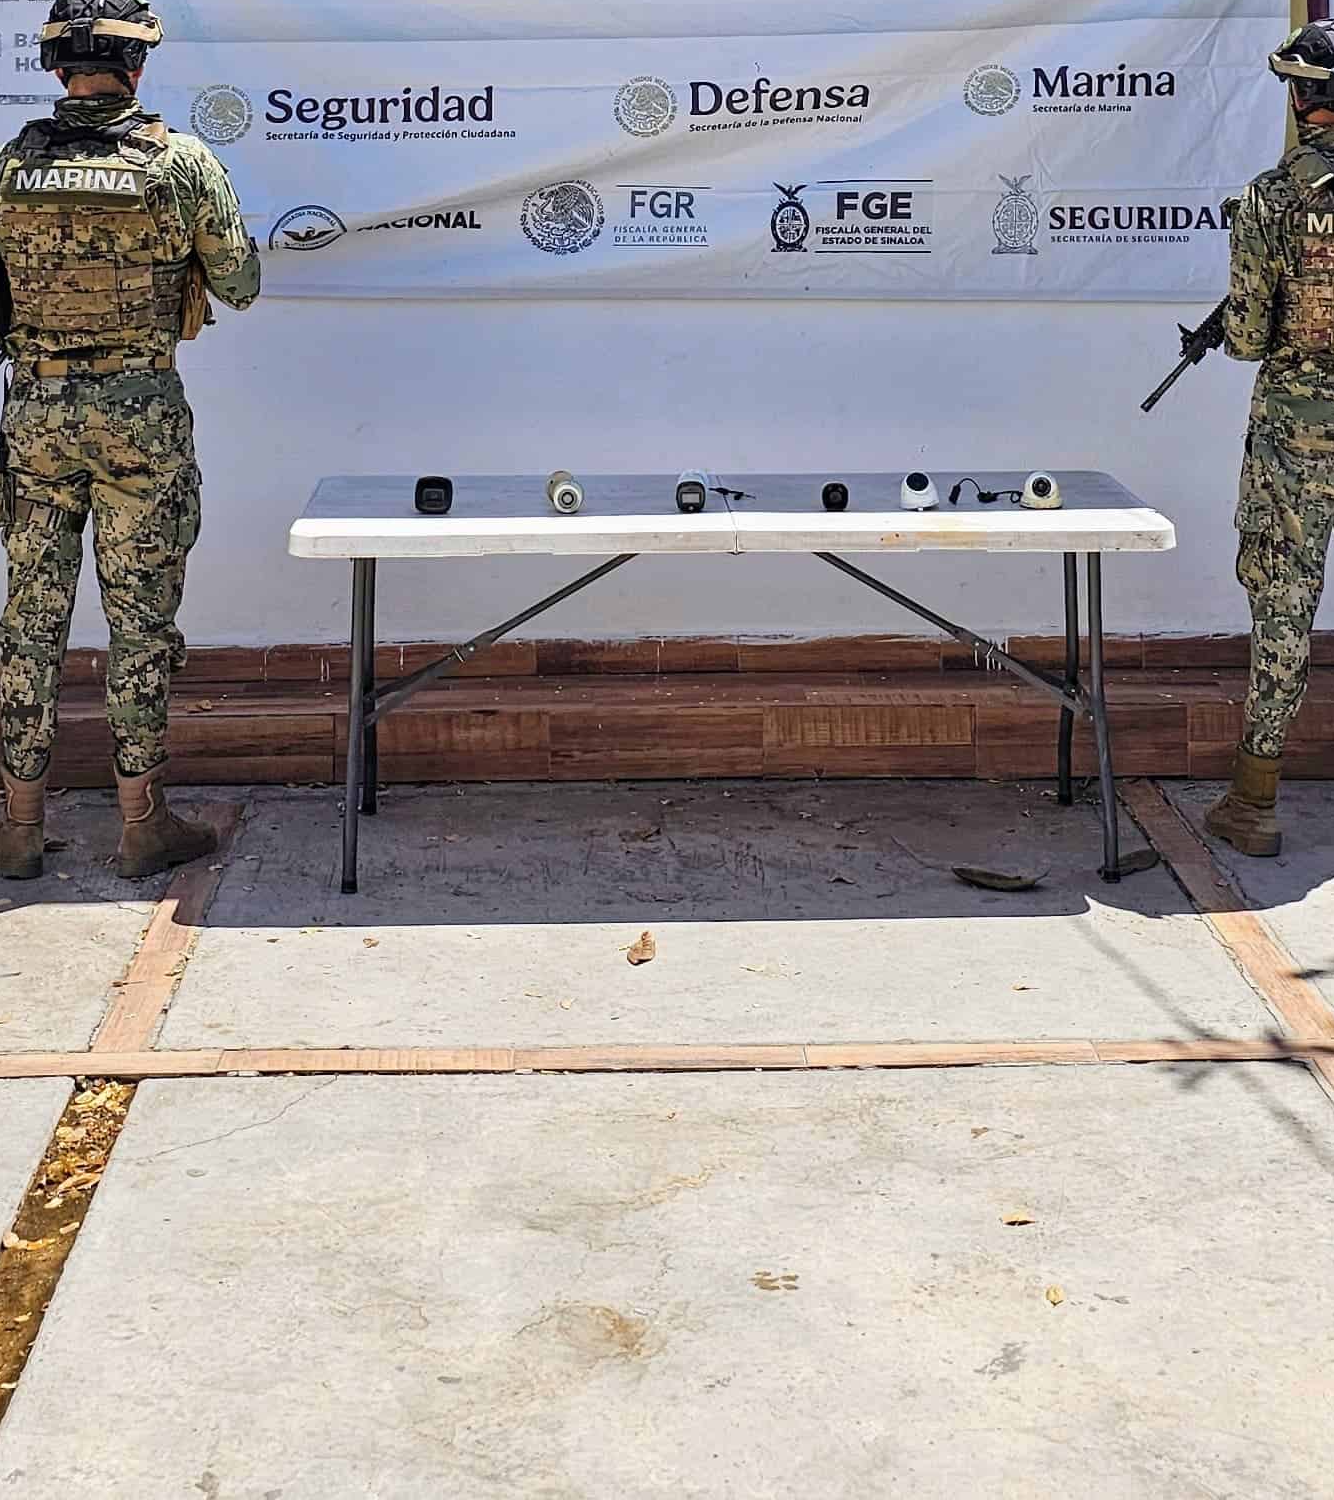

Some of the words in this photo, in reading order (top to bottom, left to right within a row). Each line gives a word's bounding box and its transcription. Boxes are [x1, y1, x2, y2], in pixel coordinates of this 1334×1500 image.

[1032, 63, 1175, 98] Marina
[688, 77, 871, 117] Defensa
[265, 85, 494, 131] Seguridad
[1032, 103, 1082, 114] Secretaría
[1083, 104, 1096, 113] de
[1098, 103, 1132, 113] Marina
[688, 119, 742, 133] Secretaría
[744, 118, 757, 128] de
[759, 117, 769, 127] la
[772, 115, 813, 126] Defensa
[816, 113, 863, 124] Nacional
[265, 130, 319, 141] Secretaría
[321, 131, 335, 140] de
[337, 130, 391, 142] Seguridad
[393, 132, 400, 142] y
[402, 129, 458, 140] Protección
[460, 128, 516, 139] Ciudadana
[17, 168, 137, 193] MARINA
[630, 190, 695, 219] FGR
[835, 191, 913, 220] FGE
[613, 223, 659, 234] FISCALÍA
[662, 225, 708, 234] GENERAL
[815, 224, 861, 235] FISCALÍA
[863, 226, 910, 235] GENERAL
[912, 226, 932, 235] DEL
[614, 235, 627, 244] DE
[631, 236, 643, 244] LA
[648, 233, 708, 244] REPÚBLICA
[822, 236, 861, 245] ESTADO
[864, 236, 878, 245] DE
[880, 236, 925, 245] SINALOA
[1050, 233, 1113, 244] SECRETARÍA
[1115, 235, 1129, 244] DE
[1131, 235, 1190, 244] SEGURIDAD
